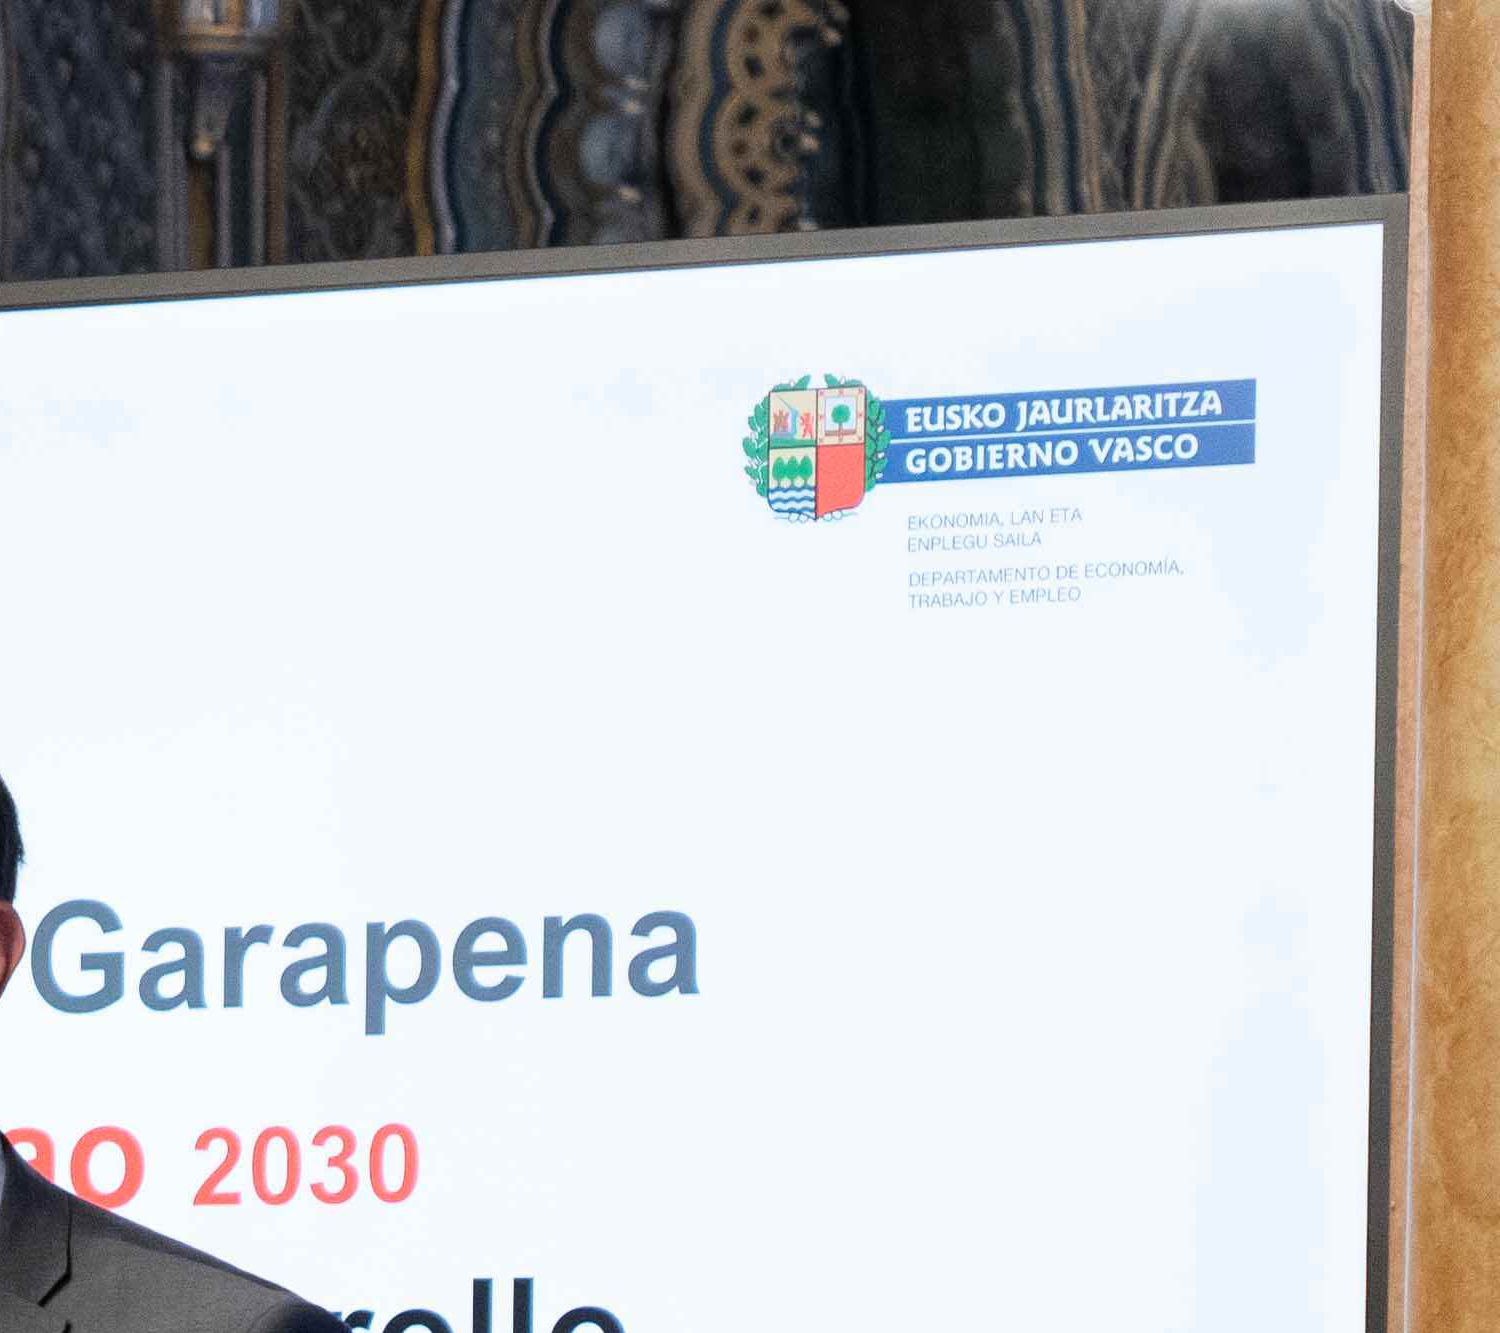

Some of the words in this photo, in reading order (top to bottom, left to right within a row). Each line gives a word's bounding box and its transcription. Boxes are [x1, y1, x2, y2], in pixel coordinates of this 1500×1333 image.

[905, 401, 1005, 433] EUSKO
[1015, 389, 1222, 431] JAURLARITZA
[905, 440, 1078, 474] GOBIERNO
[1088, 433, 1199, 464] VASCO
[907, 512, 1005, 531] EKONOMIA,
[1010, 510, 1044, 526] LAN
[1050, 507, 1083, 524] ETA
[907, 534, 988, 553] ENPLEGU
[993, 532, 1042, 548] SAILA
[908, 566, 1051, 587] DEPARTAMENTO
[1056, 564, 1079, 580] DE
[1084, 556, 1185, 579] ECONOMÍA,
[908, 591, 988, 609] TRABAJO
[993, 591, 1005, 606] Y
[1009, 586, 1082, 604] EMPLEO
[30, 898, 700, 1037] Garapena
[192, 1123, 420, 1207] 2030
